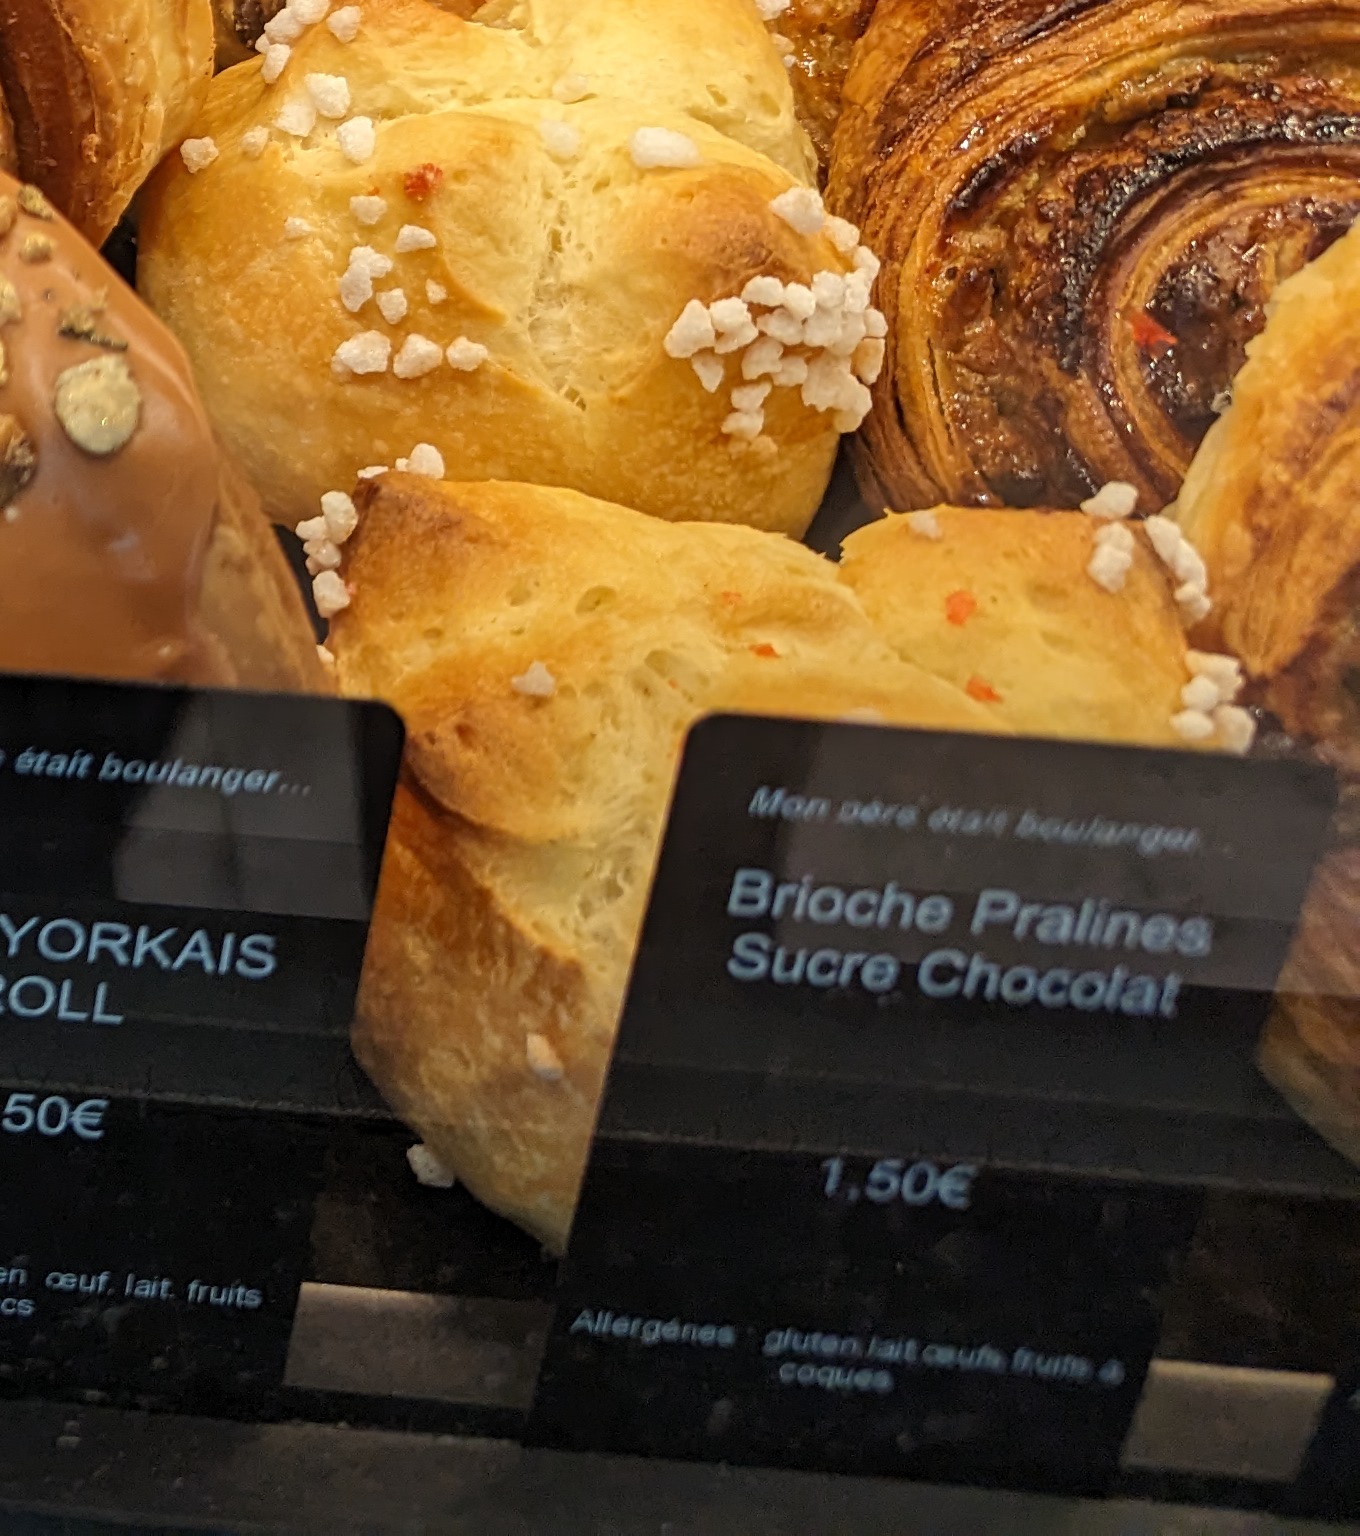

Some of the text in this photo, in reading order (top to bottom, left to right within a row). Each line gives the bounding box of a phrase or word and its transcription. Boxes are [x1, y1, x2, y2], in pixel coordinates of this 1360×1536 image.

[14, 746, 93, 780] était
[727, 868, 1214, 958] Brioche Pralines
[727, 933, 1184, 1019] Sucre Chocolat
[820, 1157, 978, 1210] 1,50€
[186, 1279, 263, 1310] fruits
